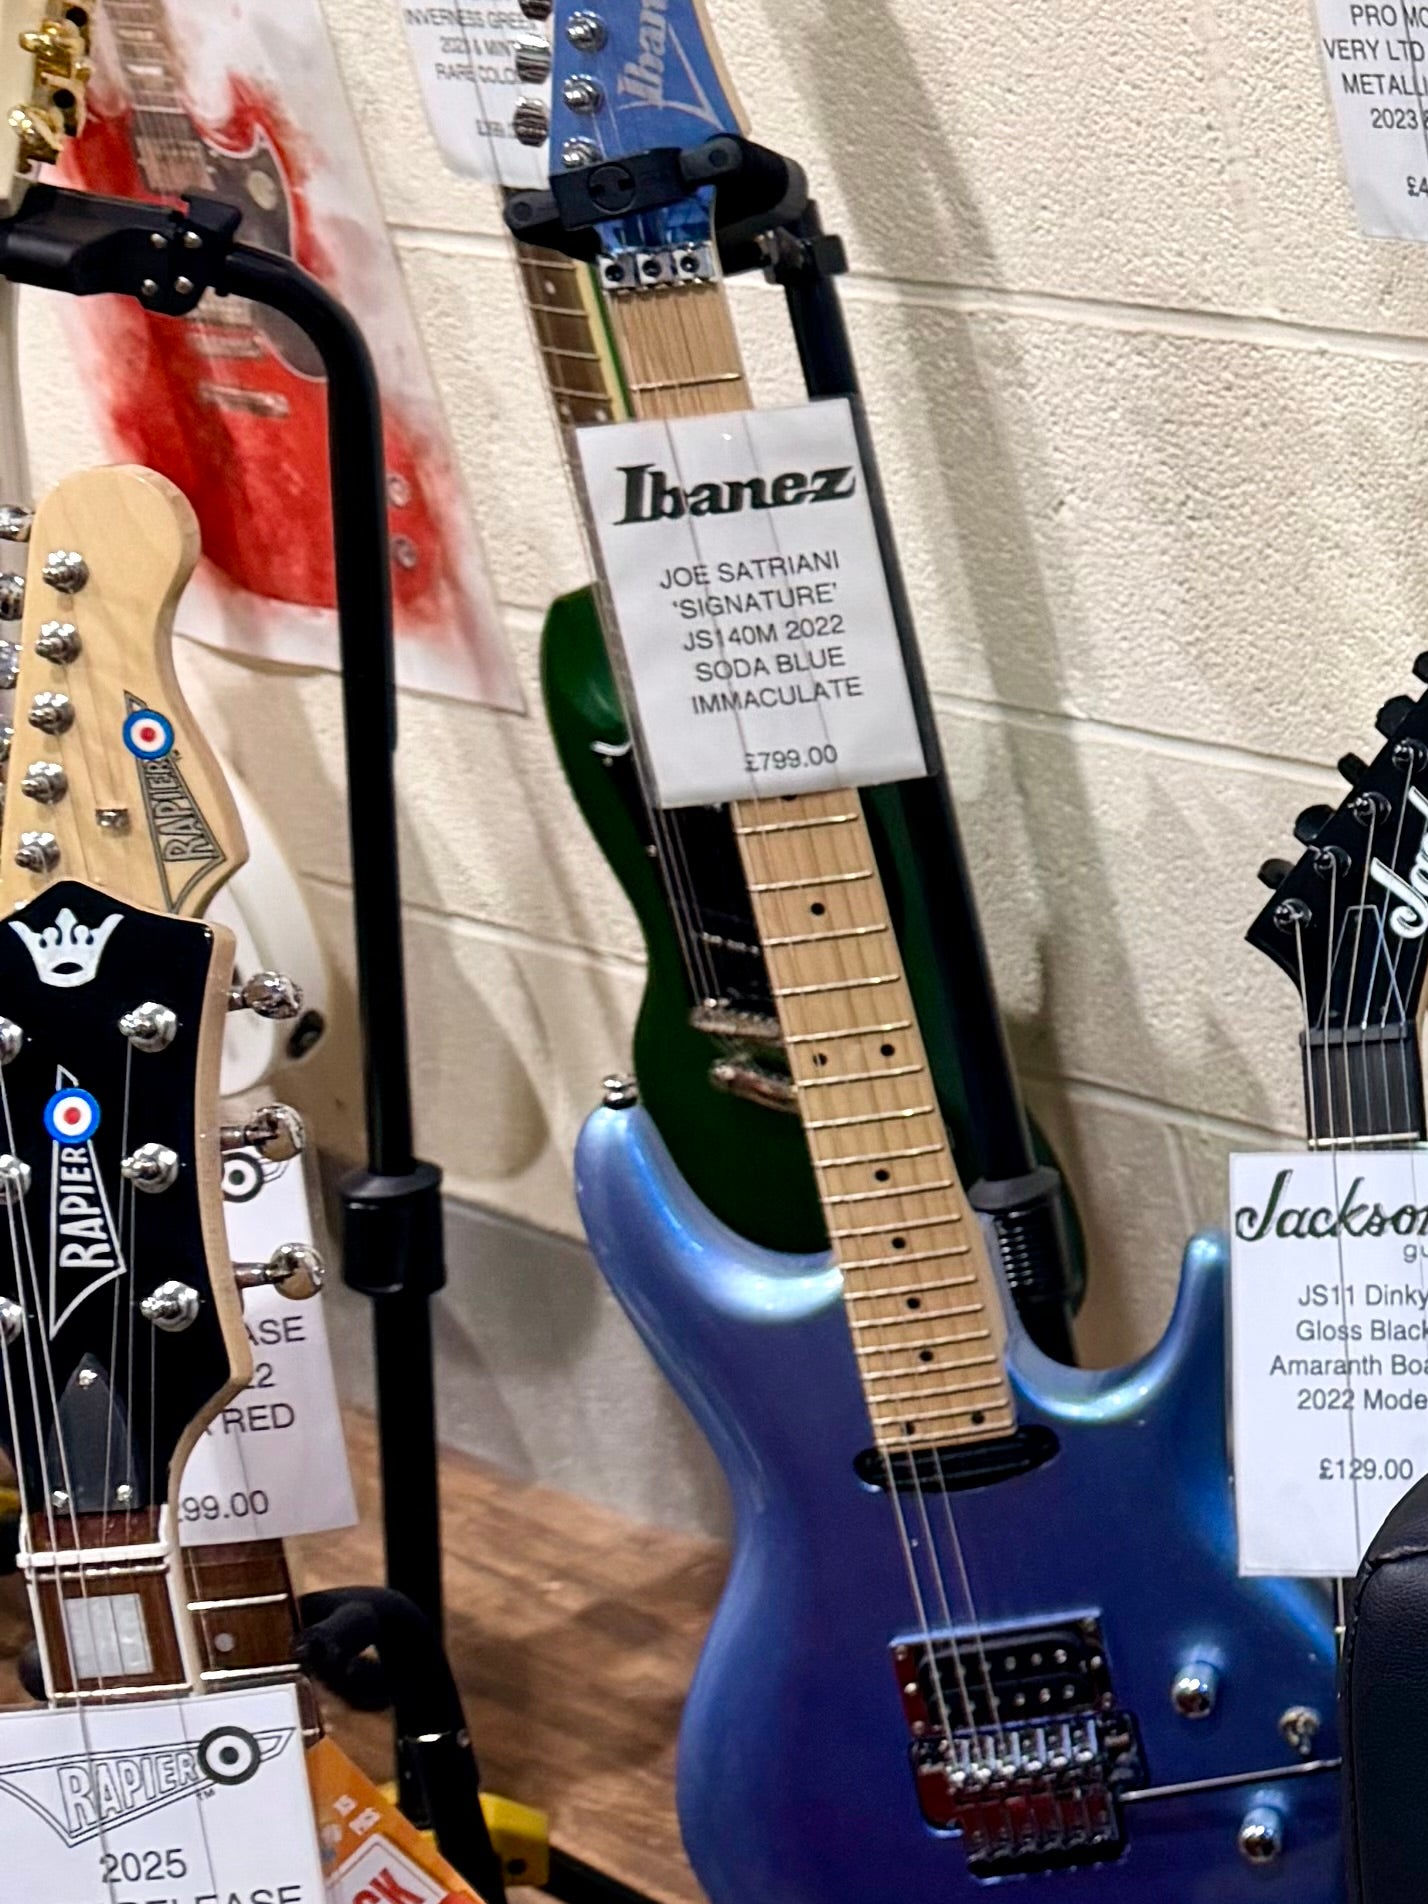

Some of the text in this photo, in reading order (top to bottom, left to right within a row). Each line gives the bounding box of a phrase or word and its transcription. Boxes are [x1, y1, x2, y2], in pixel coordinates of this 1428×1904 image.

[1350, 4, 1397, 27] PRO
[1322, 39, 1380, 62] VERY
[1387, 40, 1425, 64] LTD
[1370, 108, 1419, 130] 2023
[612, 463, 857, 526] Ibanez
[659, 549, 840, 590] JOE SATRIANI
[673, 582, 838, 620] 'SIGNATURE'
[683, 614, 846, 652] JS140M 2022
[695, 646, 846, 682] SODA BLUE
[691, 676, 863, 715] IMMACULATE
[744, 744, 838, 773] £799.00
[144, 758, 216, 864] RAPIER
[58, 1146, 115, 1270] RAPIER
[1298, 1284, 1355, 1307] JS11
[1296, 1319, 1363, 1342] Gloss
[1270, 1354, 1383, 1376] Amaranth
[1297, 1388, 1355, 1411] 2022
[221, 1402, 295, 1435] RED
[1318, 1457, 1414, 1481] £129.00
[178, 1489, 269, 1523] 99.00
[57, 1749, 200, 1836] RAPIER
[99, 1848, 188, 1884] 2025
